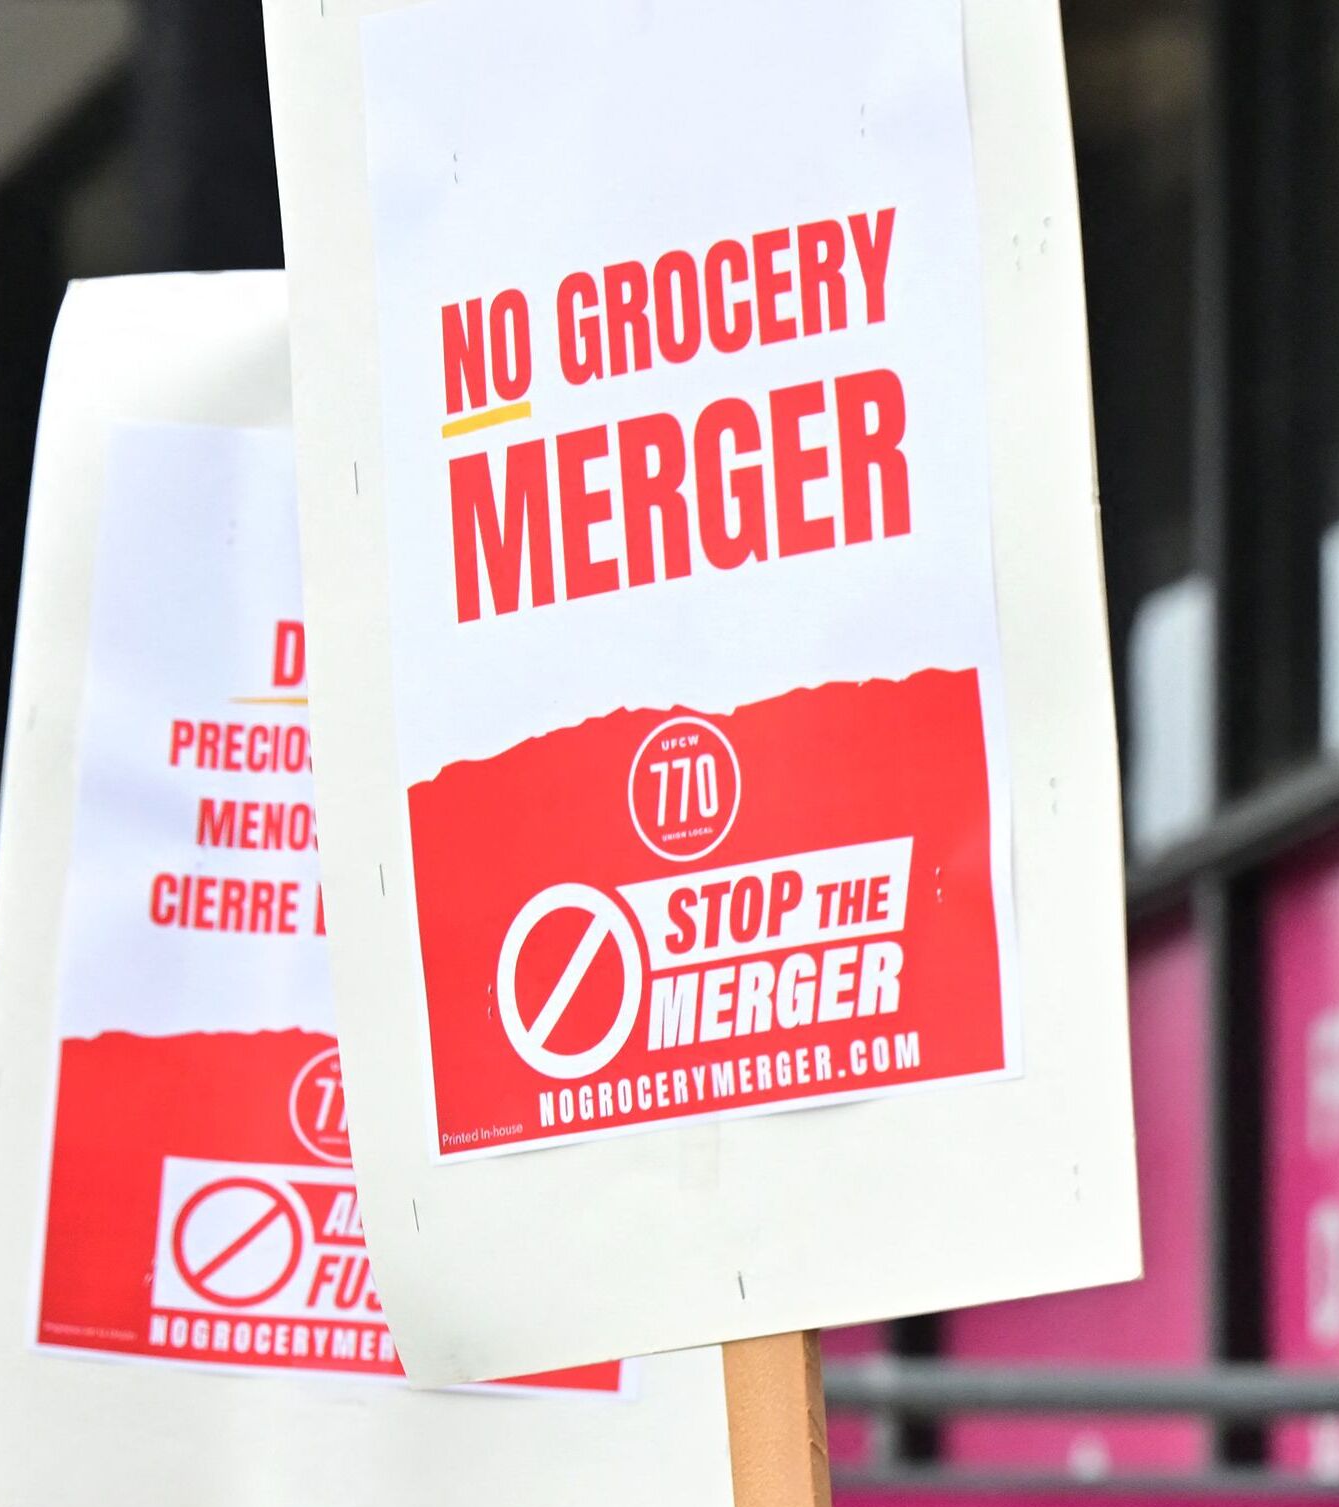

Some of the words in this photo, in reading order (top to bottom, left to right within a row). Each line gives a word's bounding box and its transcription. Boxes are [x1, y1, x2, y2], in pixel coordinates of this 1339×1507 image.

[441, 288, 532, 415] NO
[556, 207, 897, 386] GROCERY
[449, 368, 912, 624] MERGER
[169, 719, 312, 774] PRECIO
[661, 735, 699, 751] UFCW
[650, 753, 719, 827] 770
[196, 797, 318, 853] MENO
[688, 826, 713, 838] LOCAL
[149, 871, 299, 934] CIERRE
[664, 869, 803, 955] STOP
[816, 875, 891, 929] THE
[647, 941, 904, 1052] MERGER
[539, 1032, 921, 1127] NOGROCERYMERGER.COM
[442, 1129, 479, 1147] Printed
[480, 1122, 523, 1140] In-house
